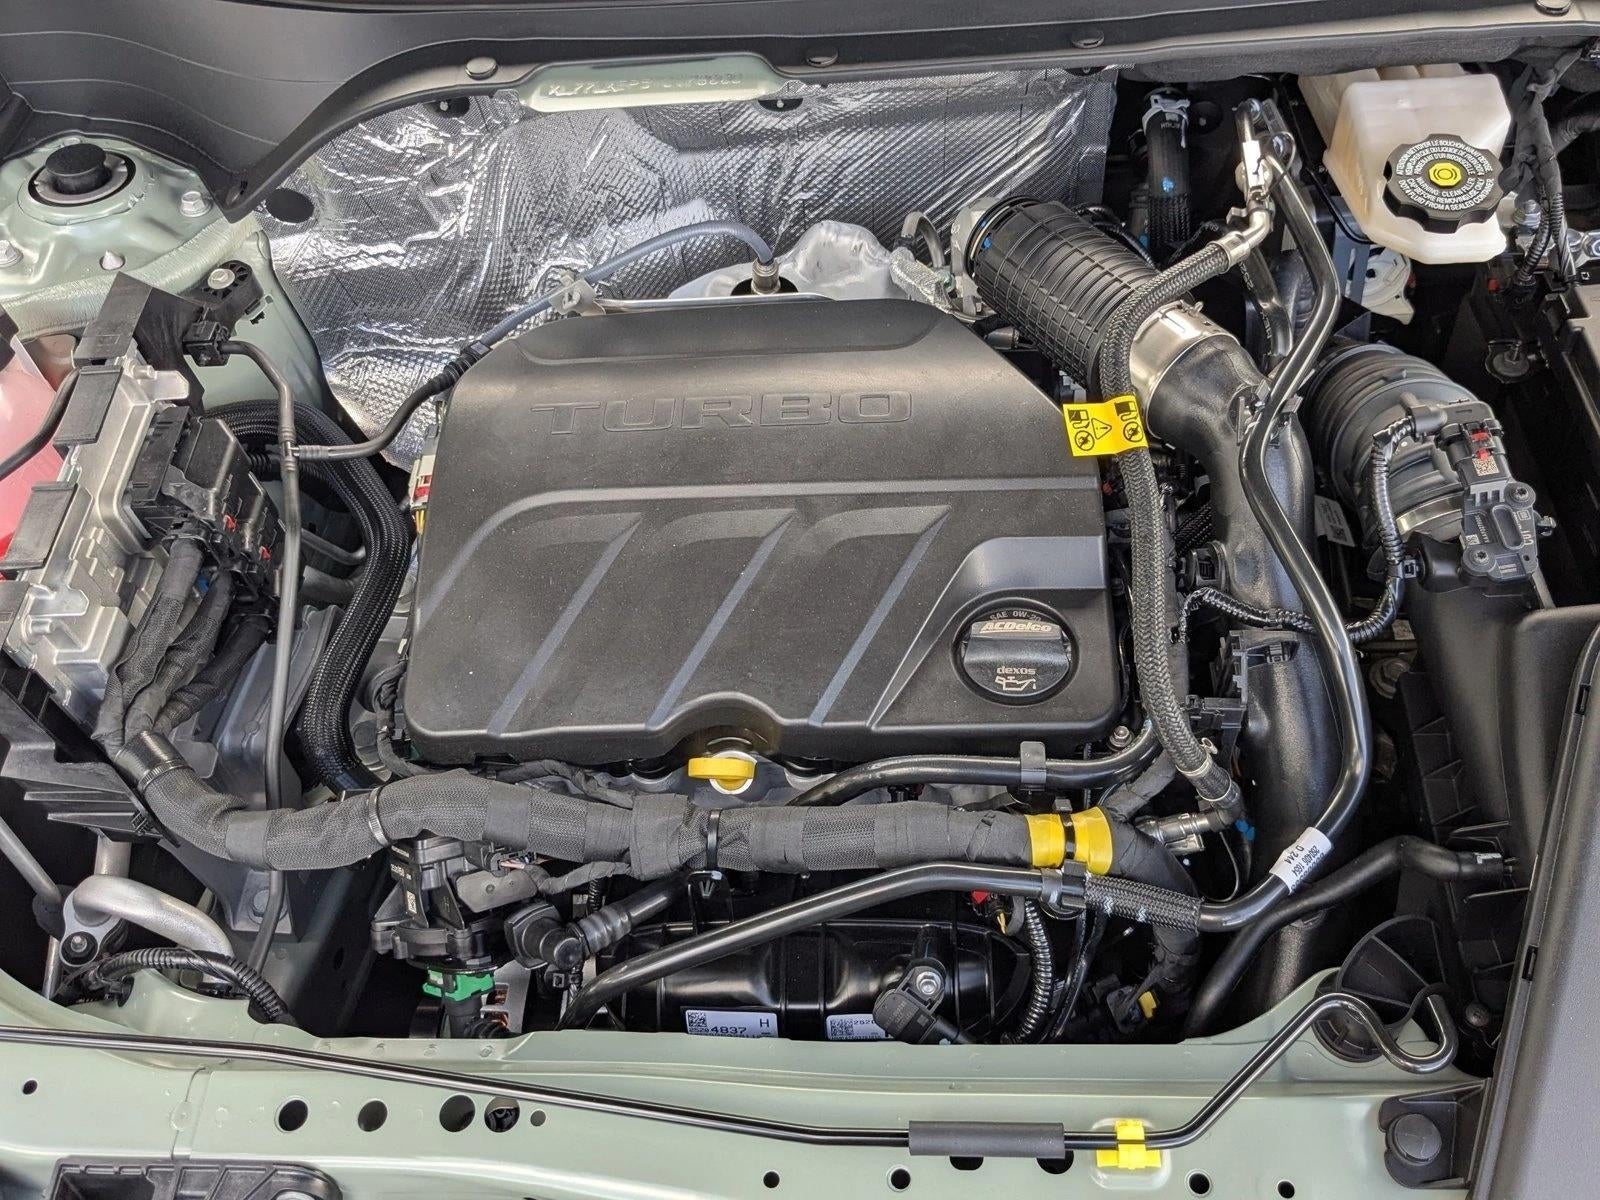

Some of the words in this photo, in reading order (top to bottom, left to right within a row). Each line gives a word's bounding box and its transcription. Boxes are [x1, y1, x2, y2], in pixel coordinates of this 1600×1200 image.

[531, 391, 912, 435] TURBO
[990, 611, 1009, 621] SAE
[1012, 610, 1042, 621] 0W-20
[980, 621, 1052, 633] ACDelco
[997, 666, 1036, 675] dexos
[759, 1018, 770, 1028] H
